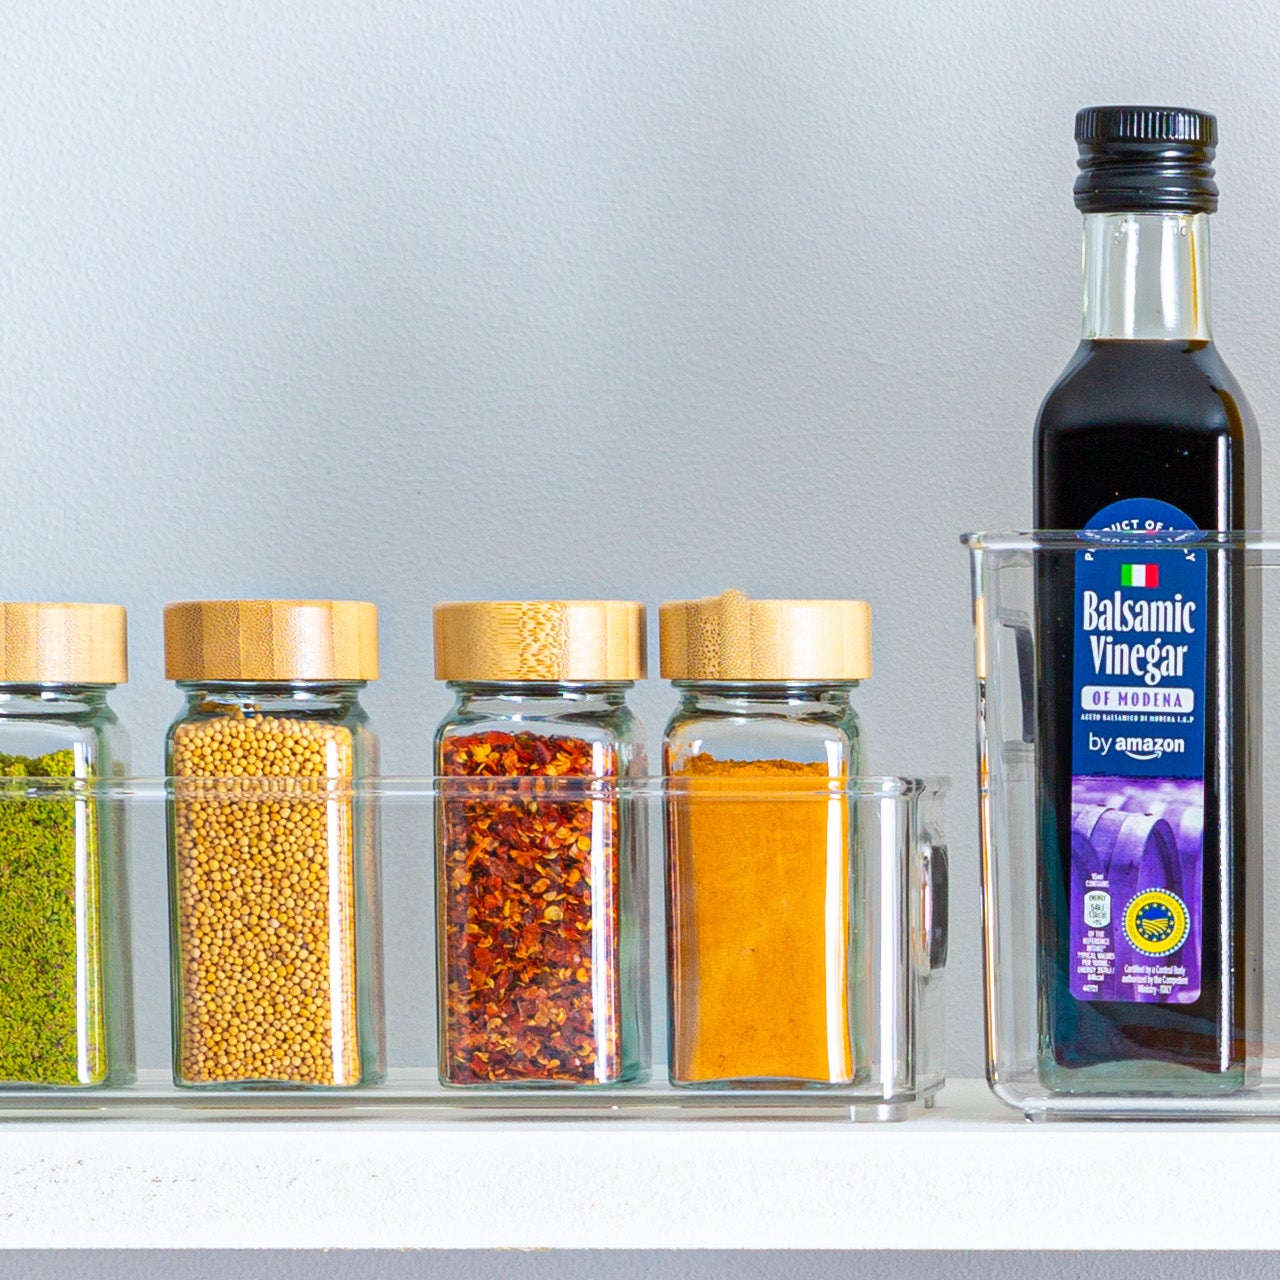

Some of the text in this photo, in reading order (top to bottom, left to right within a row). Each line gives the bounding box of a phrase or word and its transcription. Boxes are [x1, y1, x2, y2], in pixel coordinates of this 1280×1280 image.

[1083, 590, 1195, 633] Balsamic
[1090, 635, 1188, 685] Vinegar
[1093, 691, 1182, 707] OF MODENA
[1089, 732, 1185, 755] by amazon
